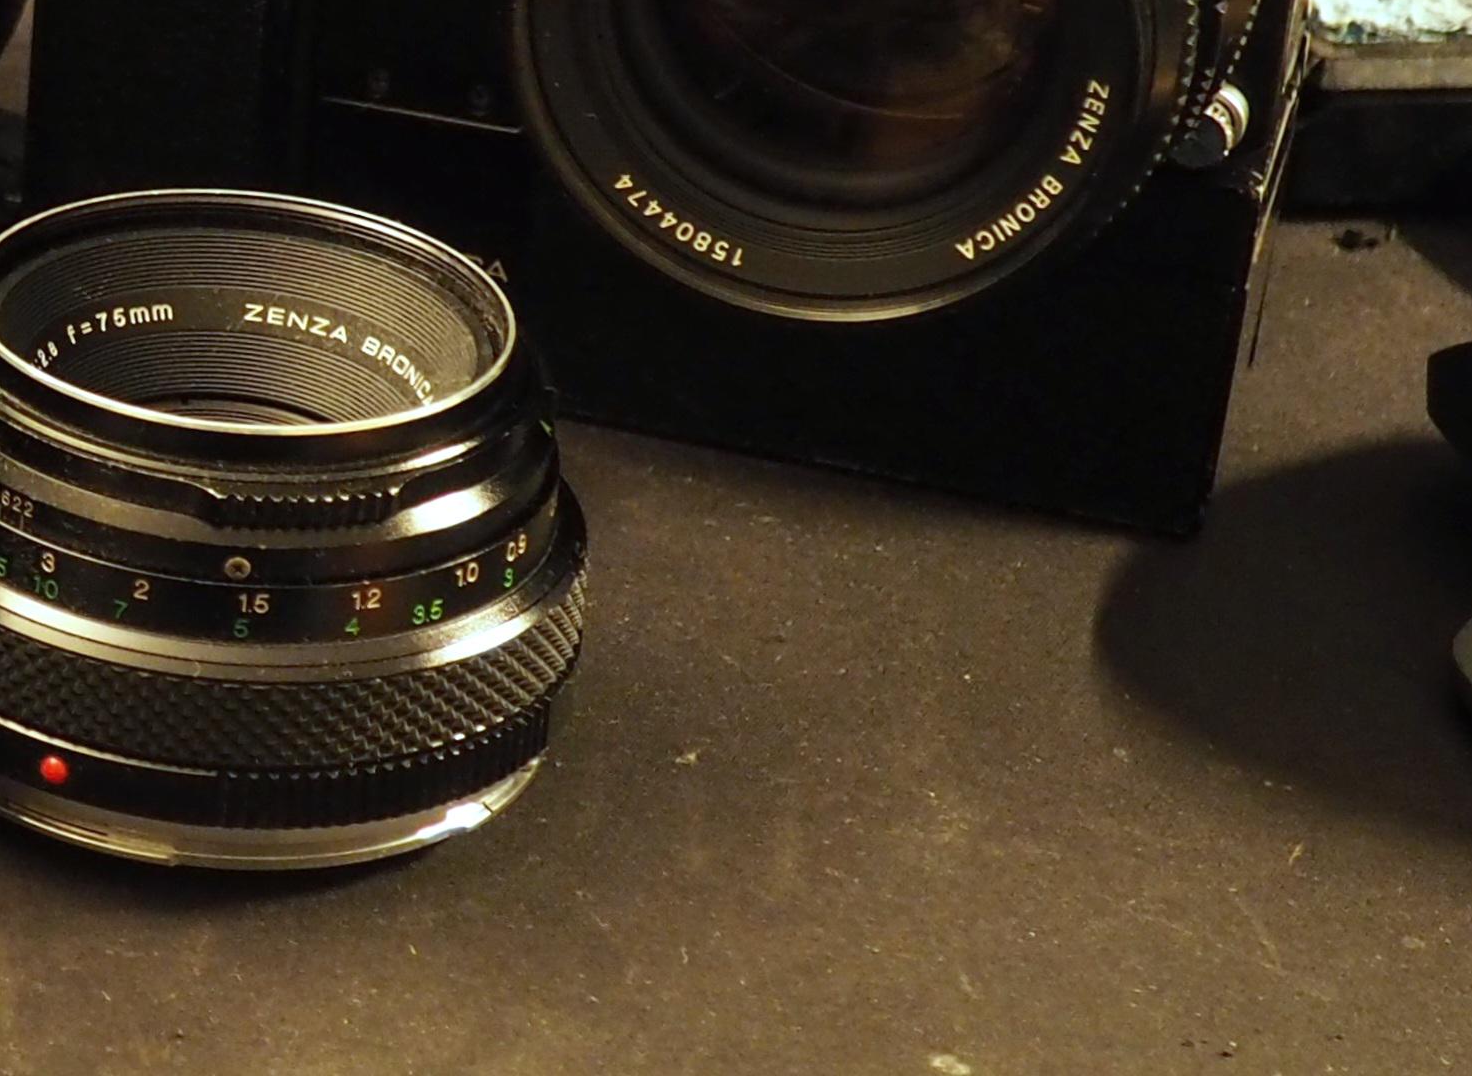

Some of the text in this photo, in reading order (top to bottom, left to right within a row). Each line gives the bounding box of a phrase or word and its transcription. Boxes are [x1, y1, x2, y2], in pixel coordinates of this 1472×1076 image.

[955, 78, 1112, 262] ZENZA BRONICA
[612, 172, 745, 270] 15804474
[243, 302, 349, 344] ZENZA
[12, 495, 35, 519] 22
[33, 574, 60, 600] 10
[113, 598, 129, 620] 7
[233, 618, 250, 639] 5
[345, 616, 361, 637] 4
[41, 552, 56, 574] 3
[133, 578, 150, 601] 2
[238, 592, 271, 615] 1.5
[351, 588, 382, 611] 1.2
[455, 561, 480, 588] 1.0
